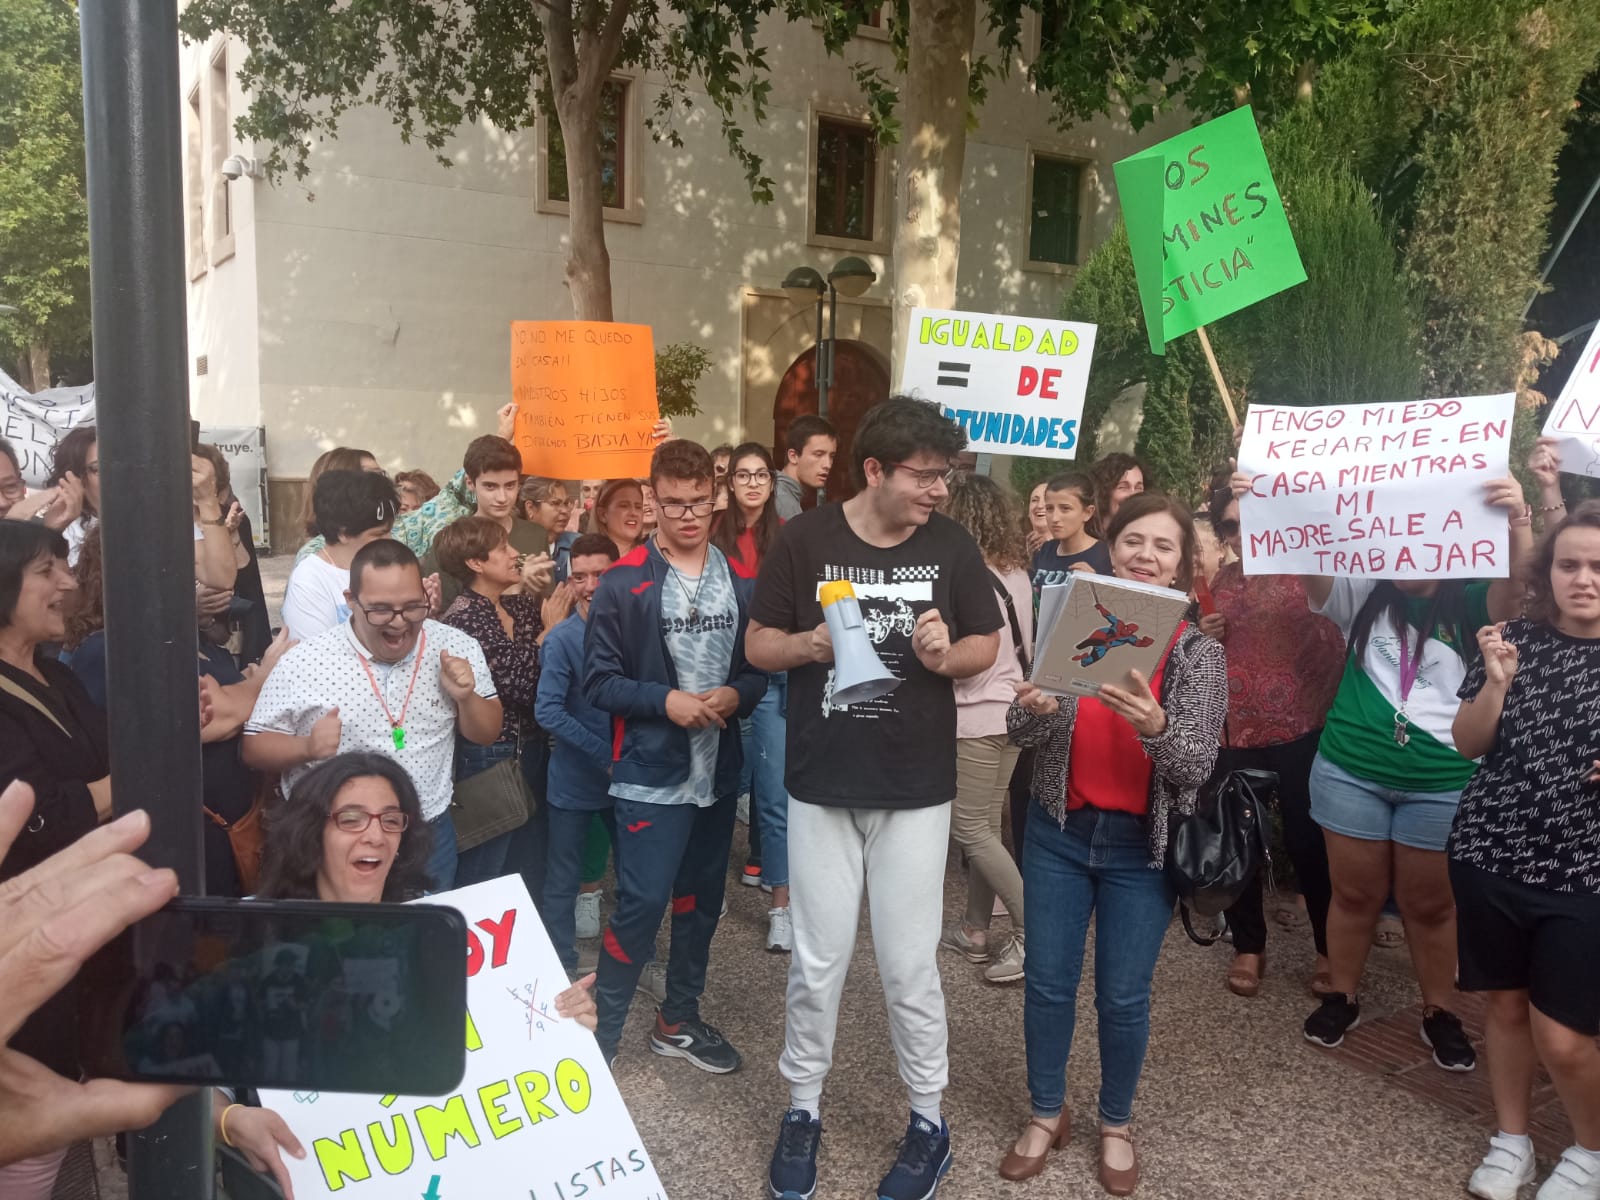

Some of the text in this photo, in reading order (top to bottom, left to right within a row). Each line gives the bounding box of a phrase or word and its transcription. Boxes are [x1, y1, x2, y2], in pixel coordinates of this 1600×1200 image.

[555, 329, 577, 345] ME
[584, 328, 633, 346] QUEDO
[919, 316, 1079, 356] IGUALDAD
[578, 387, 628, 404] HIJOS
[1017, 366, 1062, 400] DE
[574, 412, 631, 426] TIENEN
[1250, 400, 1462, 434] TENGO MIEDO
[574, 433, 629, 449] BASTA
[1250, 453, 1488, 498] CASA MIENTRAS
[1335, 490, 1375, 516] MI
[1442, 509, 1463, 533] A
[1313, 539, 1497, 575] TRABAJAR
[312, 1057, 592, 1192] NÚMERO
